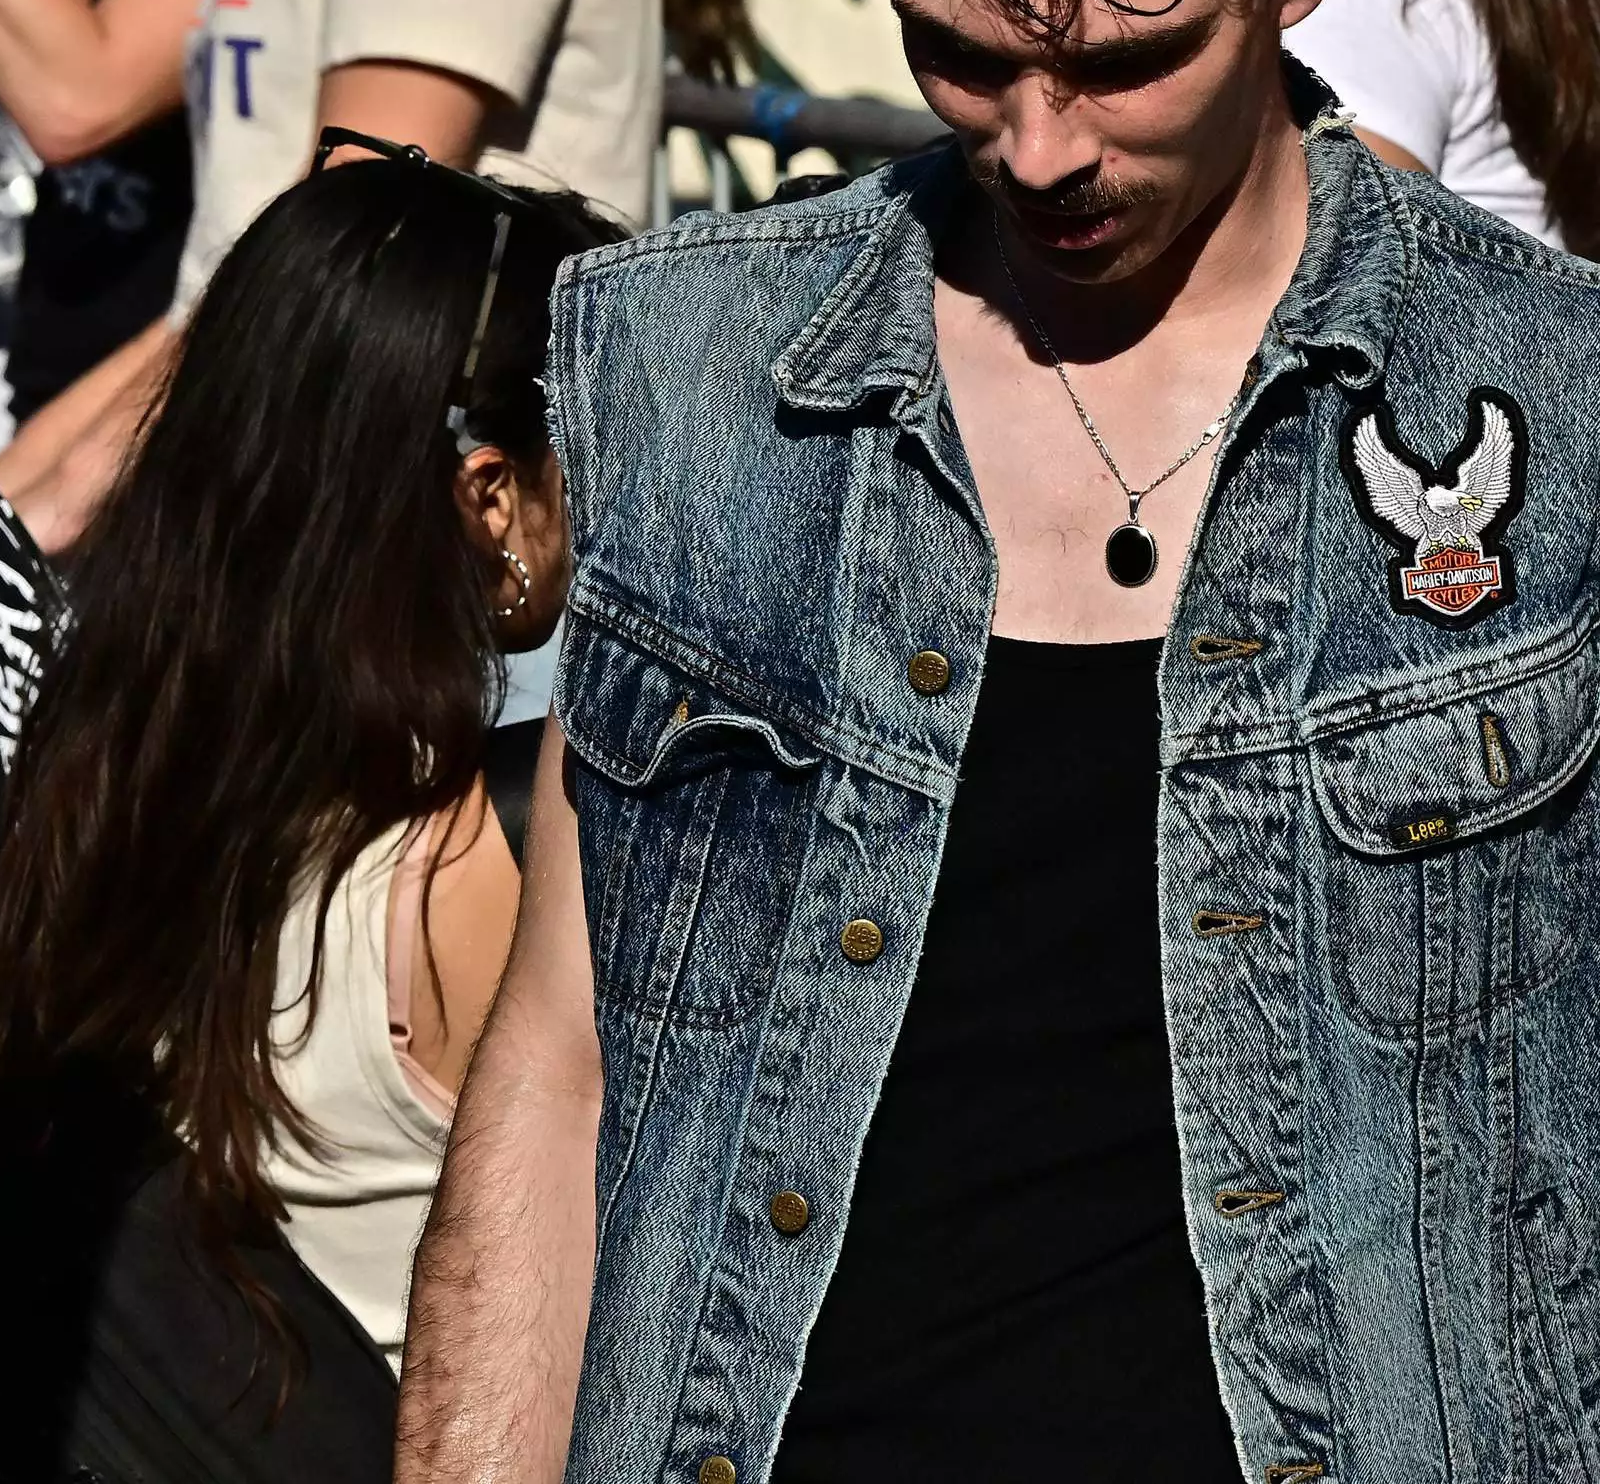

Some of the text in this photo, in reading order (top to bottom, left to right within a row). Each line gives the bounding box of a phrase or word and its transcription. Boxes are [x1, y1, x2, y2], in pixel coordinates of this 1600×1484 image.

[1429, 551, 1474, 570] MOTOR
[1411, 567, 1493, 590] HARLEY-DAVIDSON
[1433, 587, 1475, 605] CYCLES
[1408, 821, 1438, 841] Lee
